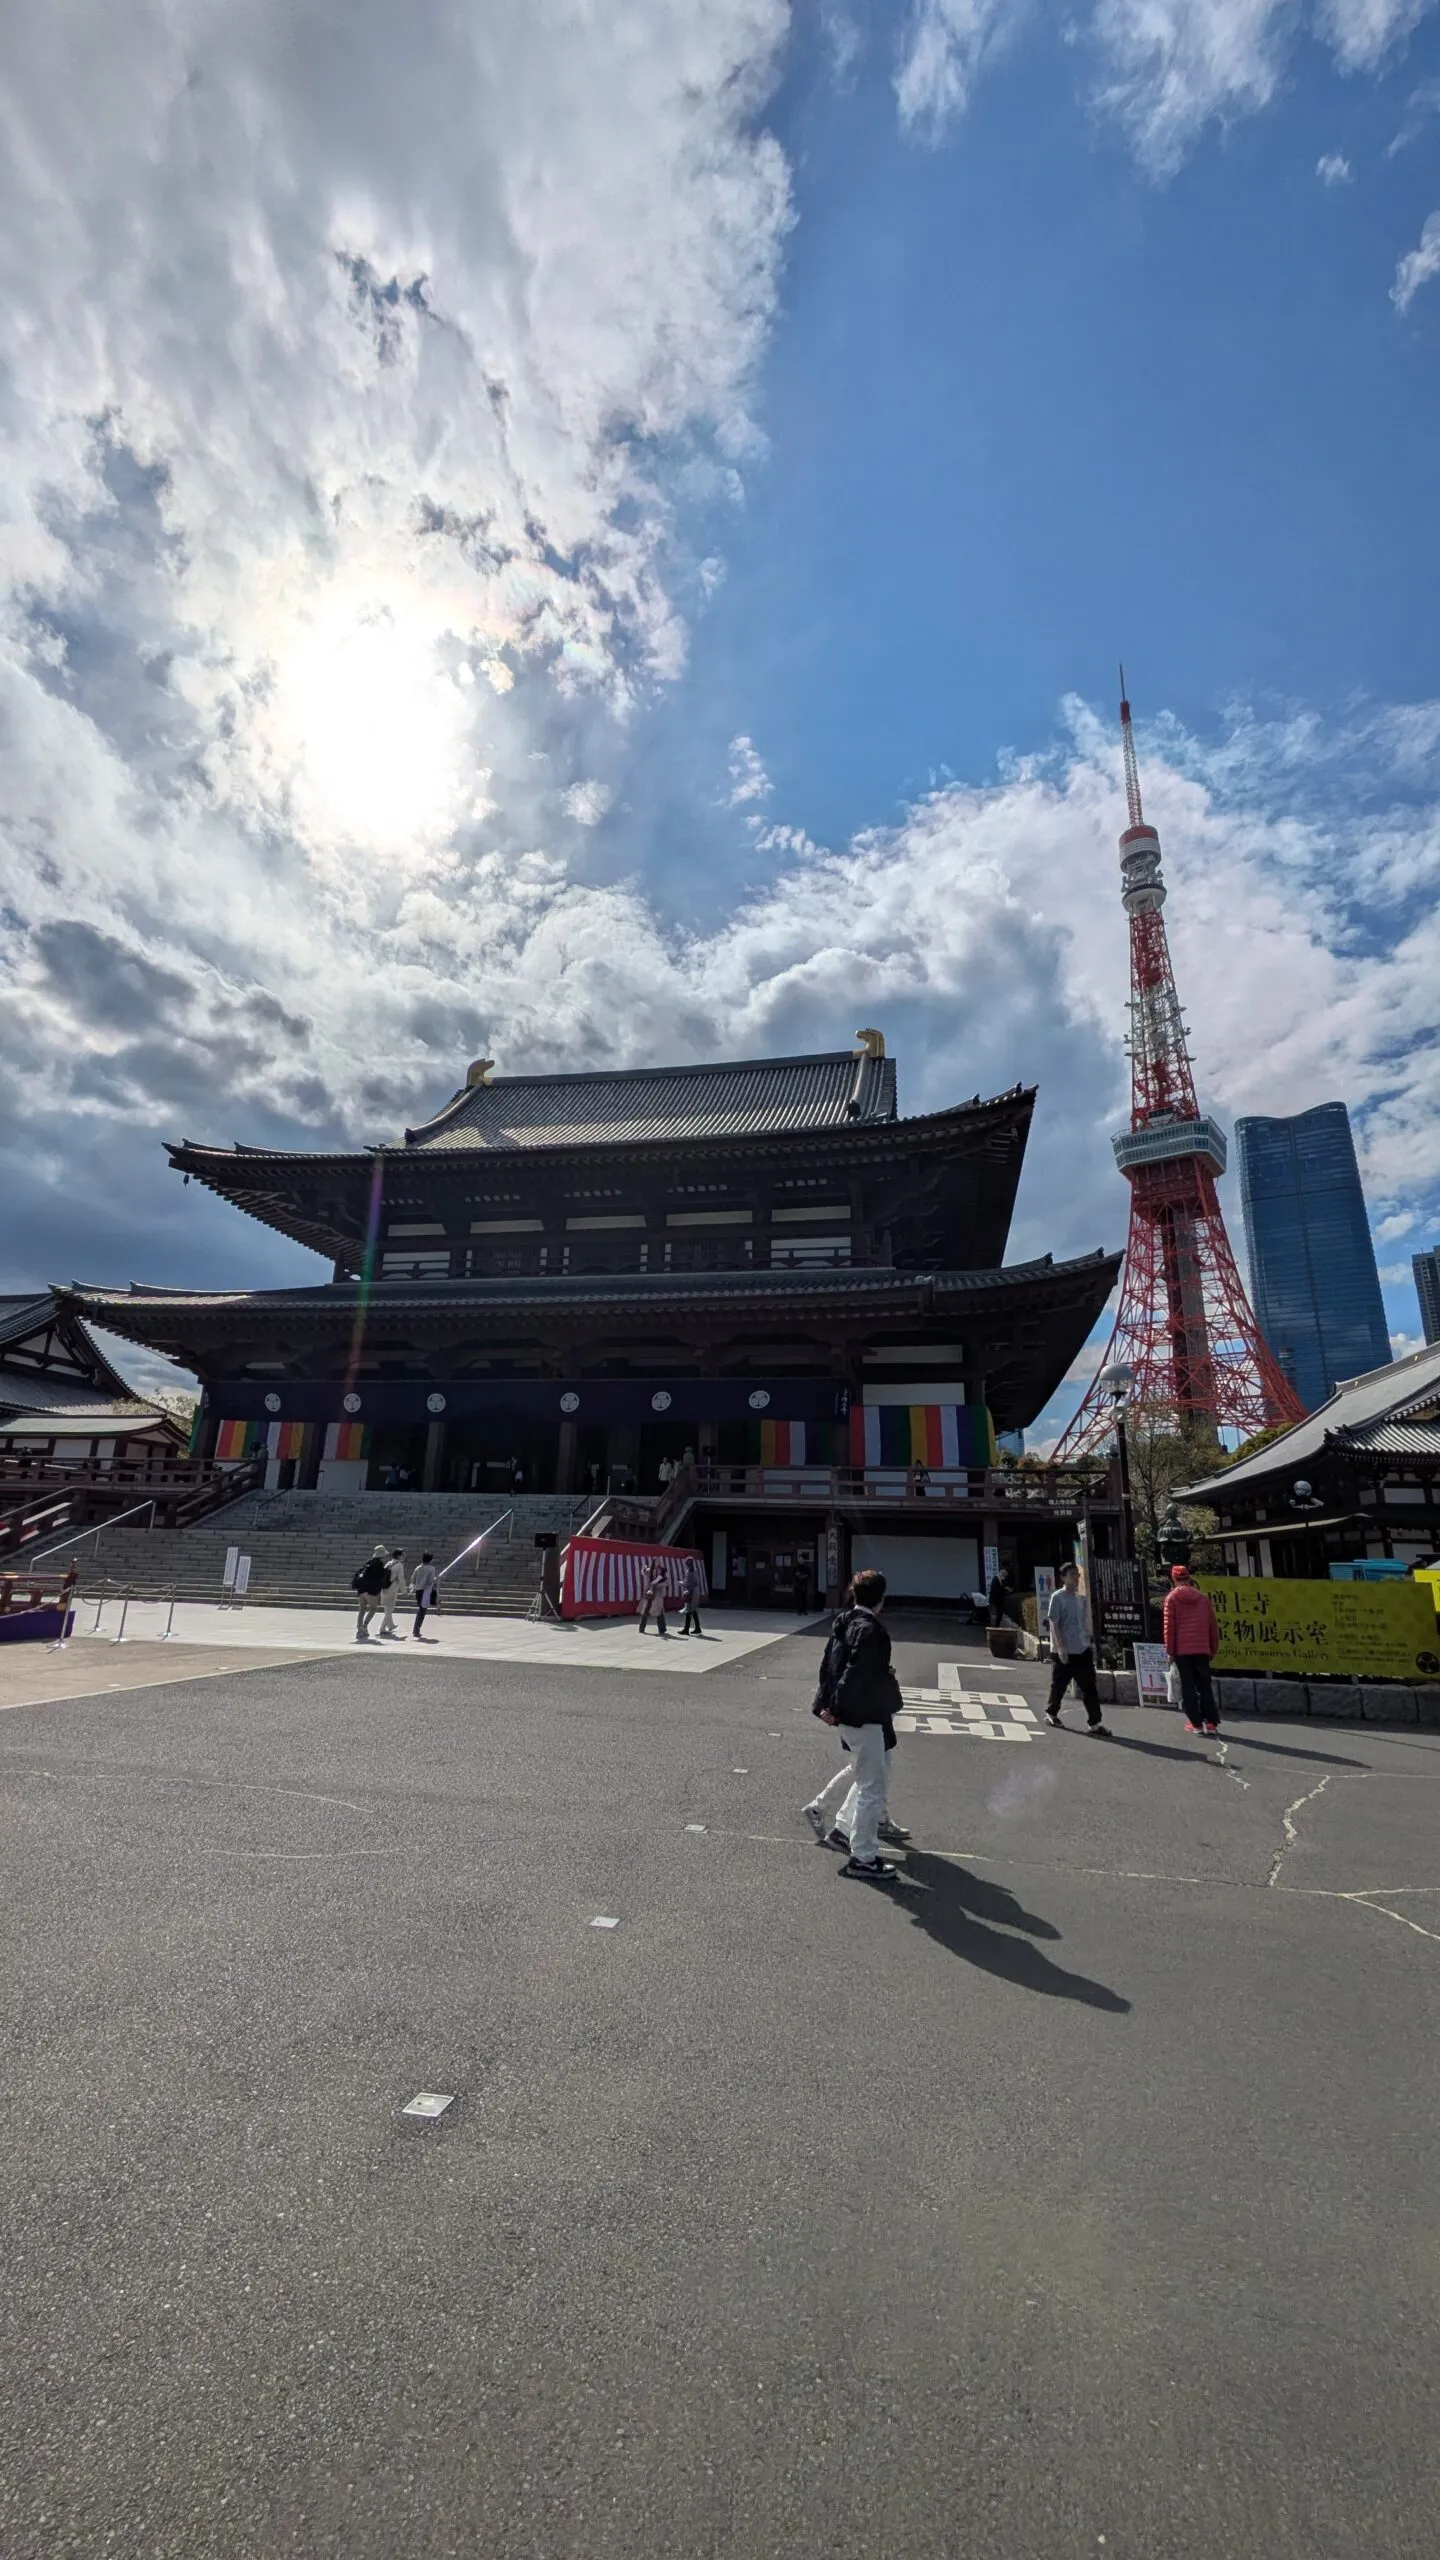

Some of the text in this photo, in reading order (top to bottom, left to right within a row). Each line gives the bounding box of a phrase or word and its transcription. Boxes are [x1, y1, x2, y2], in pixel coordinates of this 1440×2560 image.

[1208, 1590, 1270, 1615] 増上寺
[1217, 1645, 1241, 1658] ojoji
[1244, 1647, 1291, 1658] Treasures
[1293, 1648, 1329, 1661] Gallery
